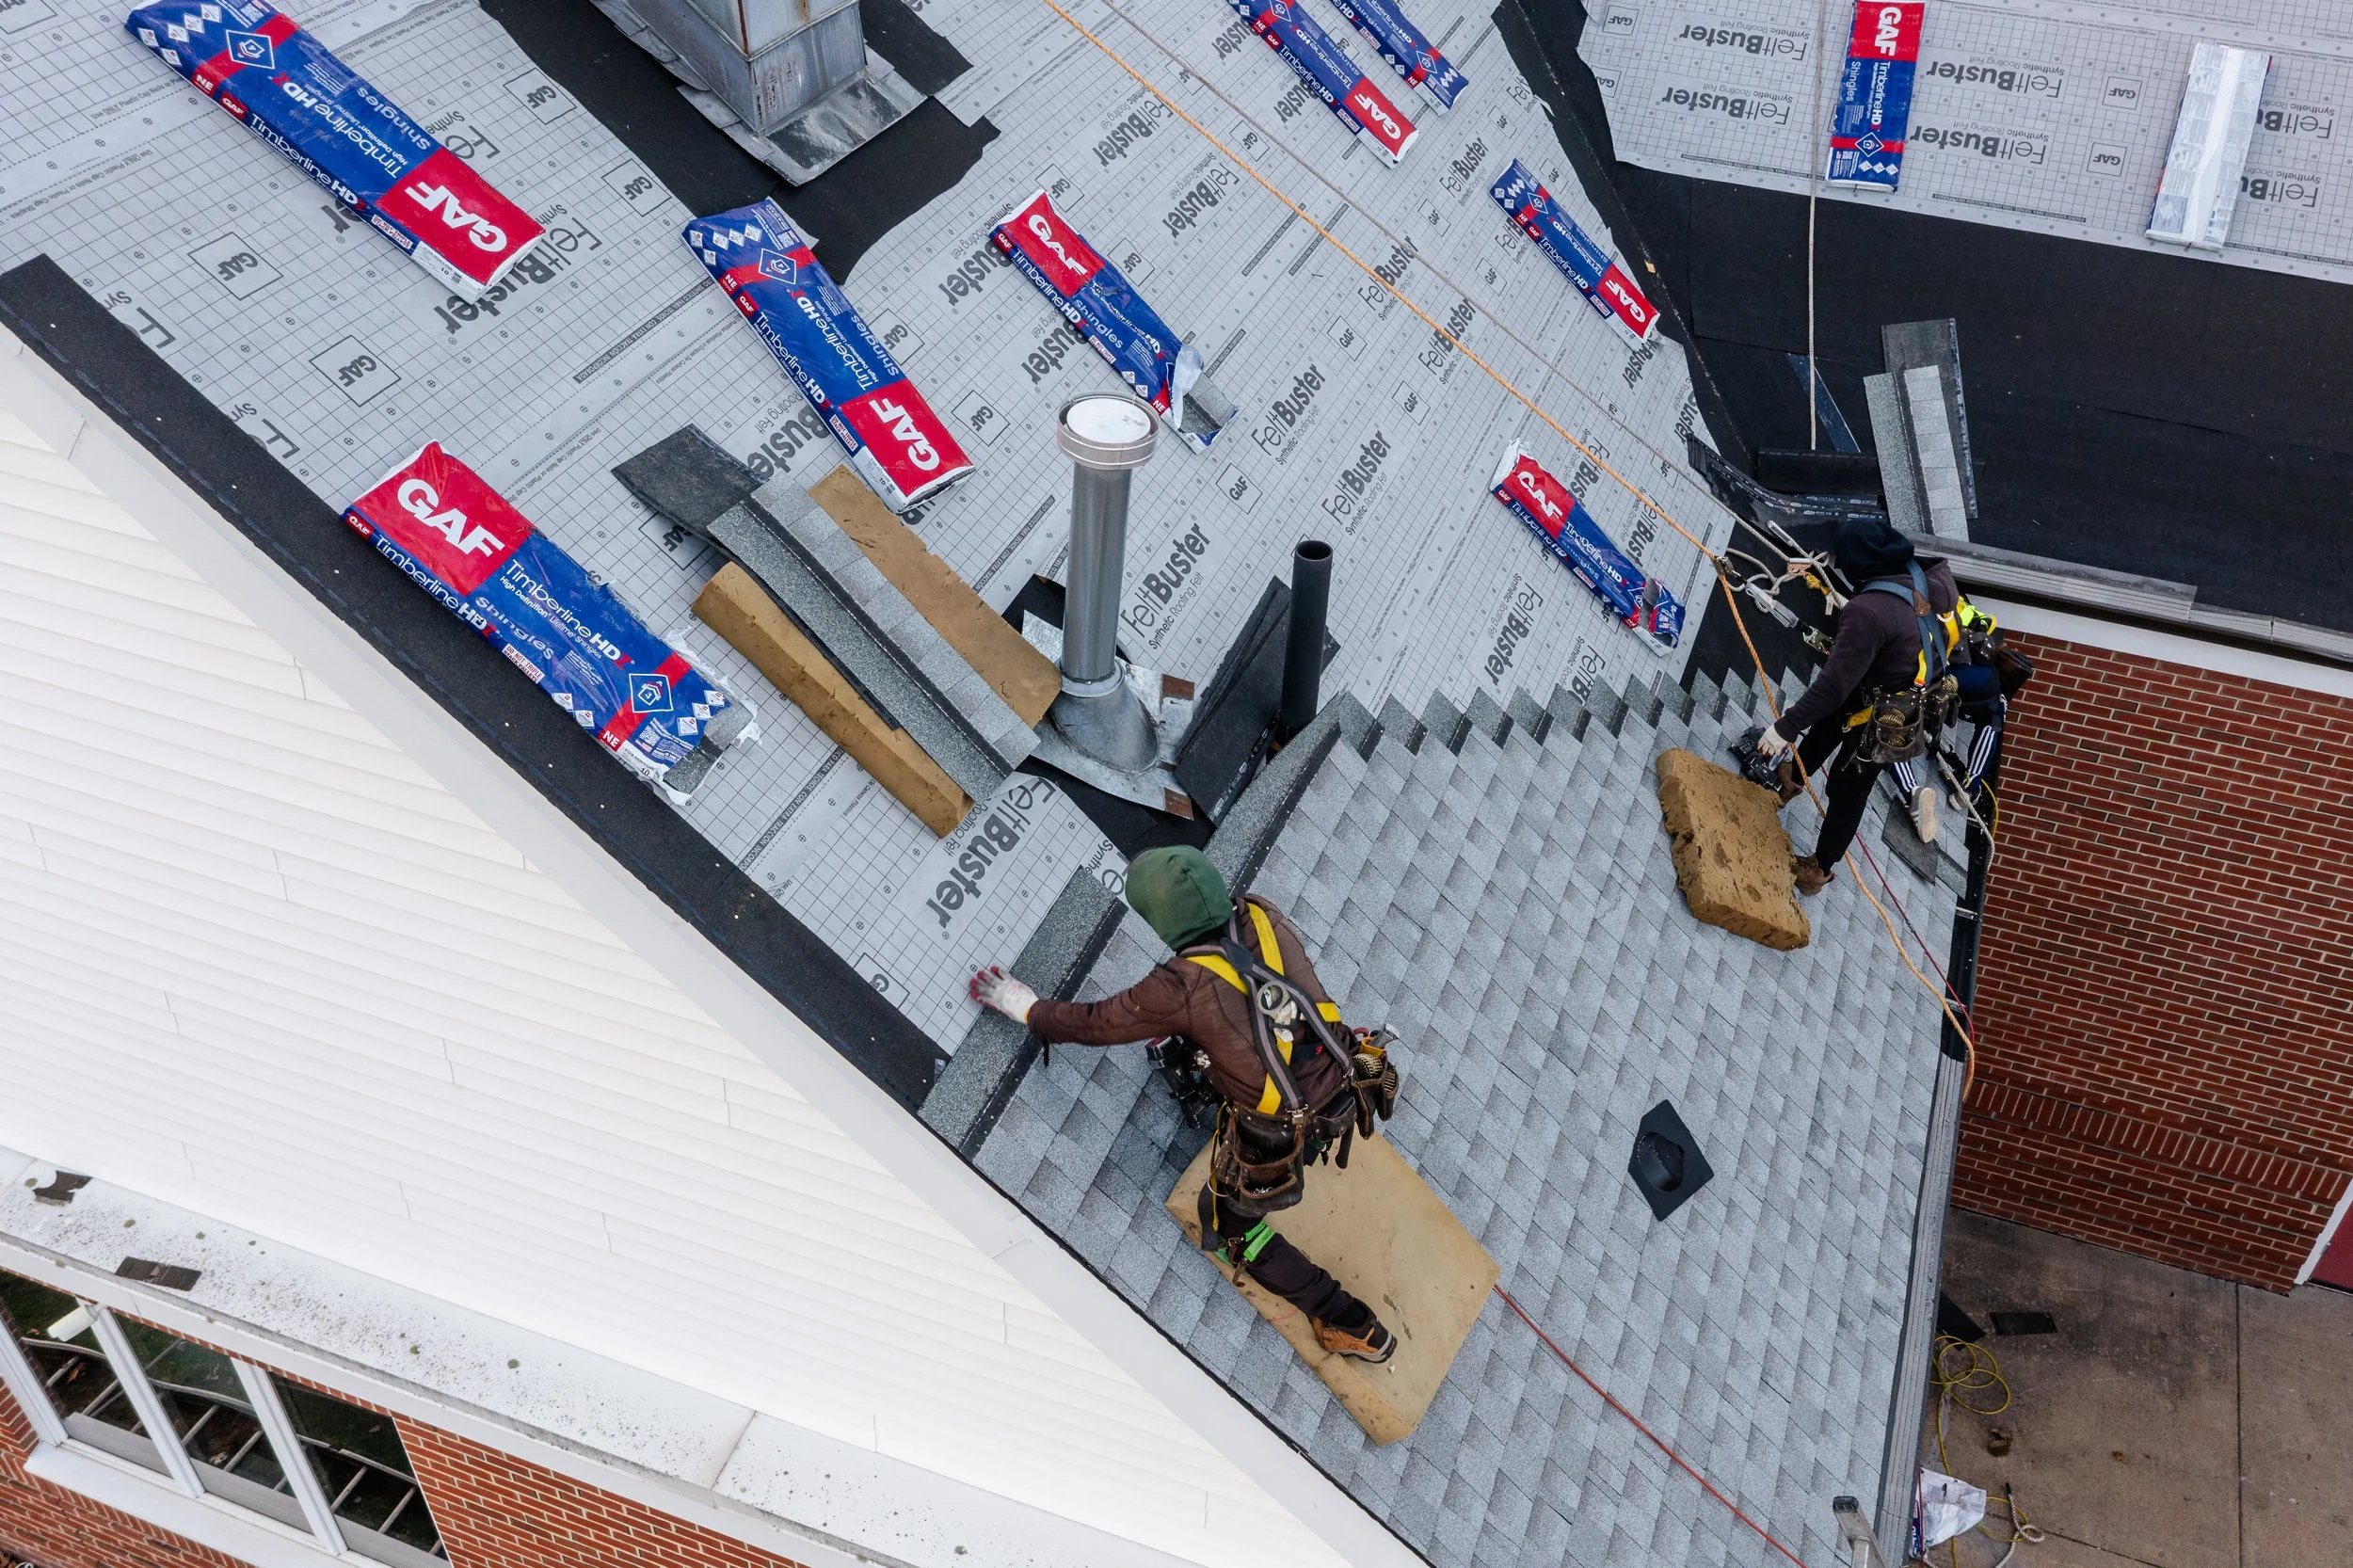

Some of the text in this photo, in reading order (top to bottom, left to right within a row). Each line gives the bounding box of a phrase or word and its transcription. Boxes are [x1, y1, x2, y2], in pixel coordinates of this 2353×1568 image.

[1255, 19, 1267, 31] NE
[1608, 15, 1633, 26] GAF
[1719, 19, 1811, 40] Synthetic Roofing Felt
[1874, 7, 1901, 56] GAF
[1266, 33, 1279, 47] GAF
[1676, 23, 1806, 61] FeltBuster
[1926, 59, 2062, 98] FeltBuster
[1968, 55, 2065, 76] Synthetic Roofing Felt
[194, 73, 215, 91] NE
[1407, 75, 1418, 87] NE
[1701, 82, 1793, 104] Synthetic Roofing Felt
[1843, 60, 1861, 102] Shingles
[2114, 88, 2137, 99] GAF
[220, 95, 244, 116] GAF
[526, 85, 557, 109] GAF
[1268, 78, 1320, 127] Buster
[1661, 87, 1789, 124] FeltBuster
[2289, 100, 2335, 117] Synthetic
[354, 84, 433, 152] Shingles
[423, 106, 465, 139] Synthe
[1097, 98, 1131, 131] Roofing Felt
[1353, 93, 1401, 138] GAF
[1497, 115, 1507, 129] GAF
[2254, 106, 2332, 140] FeltBu
[1091, 94, 1174, 168] FeltBuster
[1241, 132, 1258, 150] GAF
[1909, 123, 2046, 165] FeltBuster
[1952, 120, 2049, 142] Synthetic Roofing Felt
[391, 149, 410, 166] High
[1438, 136, 1489, 199] FeltBuster
[2094, 153, 2116, 166] GAF
[624, 176, 653, 200] GAF
[1167, 151, 1217, 200] Synthetic Roofing Felt
[1547, 168, 1559, 184] GAF
[2275, 168, 2321, 184] Synthetic
[1049, 178, 1071, 200] GAF
[1160, 161, 1240, 238] FeltBuster
[2237, 174, 2318, 208] FeltBu
[404, 184, 506, 250] GAF
[1428, 209, 1440, 225] GAF
[949, 224, 987, 262] Roofing Felt
[996, 232, 1013, 249] GAF
[1528, 225, 1541, 238] GAF
[1030, 215, 1088, 275] GAF
[217, 252, 258, 281] GAF
[937, 242, 1014, 308] Buster
[1123, 252, 1143, 274] GAF
[1485, 268, 1497, 284] GAF
[724, 272, 738, 288] NE
[738, 295, 754, 312] GAF
[1375, 295, 1401, 321] Synthetic
[1604, 279, 1646, 320] GAF
[1029, 323, 1046, 341] Felt
[1071, 296, 1126, 350] Shingles
[1417, 296, 1476, 376] FeltBuster
[848, 312, 901, 376] Shingles
[884, 324, 908, 350] GAF
[1338, 328, 1354, 348] GAF
[1016, 318, 1089, 389] Buster
[339, 355, 377, 387] GAF
[1436, 359, 1460, 385] Synthetic
[756, 388, 804, 437] Roofing Felt
[1151, 398, 1166, 413] NE
[1250, 362, 1325, 456] FeltBuster
[1403, 392, 1418, 412] GAF
[971, 406, 994, 432] GAF
[867, 399, 938, 469] GAF
[1273, 404, 1321, 467] Synthetic Roofing Felt
[554, 453, 567, 464] Cap
[877, 477, 886, 486] 10
[1229, 475, 1249, 501] GAF
[1321, 429, 1391, 525] FeltBuster
[514, 485, 527, 497] Cap
[1343, 471, 1389, 536] Synthetic Roofing Felt
[1497, 488, 1511, 503] GAF
[346, 514, 372, 536] GAF
[397, 478, 505, 557] GAF
[498, 575, 517, 591] High
[1118, 522, 1210, 638] FeltBuster
[1146, 570, 1206, 650] Synthetic Roofing Felt
[1485, 571, 1525, 639] Synthetic Roofing Felt
[472, 594, 557, 661] Shingles
[1481, 582, 1544, 686] FeltBuster
[505, 645, 543, 680] DO NOT TRIPLE
[1563, 634, 1588, 666] Synthetic
[601, 729, 621, 747] NE
[821, 759, 835, 774] PARA
[793, 790, 808, 805] CON
[855, 784, 871, 801] Cabeza
[939, 798, 990, 858] Roofing Felt
[925, 789, 1056, 928] FeltBuster
[780, 878, 792, 891] Use
